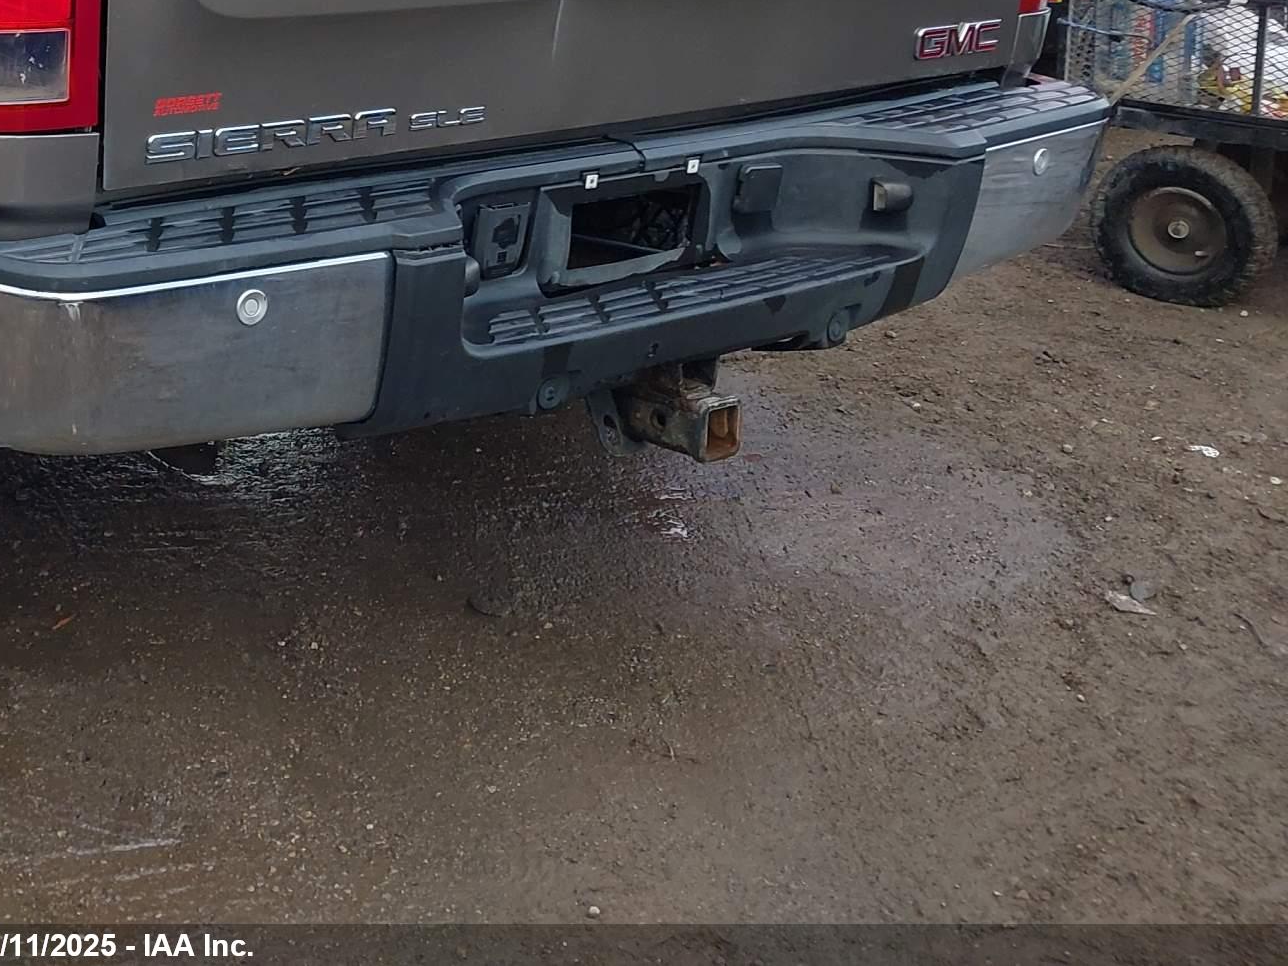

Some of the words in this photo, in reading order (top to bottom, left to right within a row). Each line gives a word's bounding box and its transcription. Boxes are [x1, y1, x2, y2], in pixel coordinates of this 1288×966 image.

[914, 19, 1002, 60] GMC
[146, 109, 396, 164] SIERRA
[410, 107, 486, 131] SLE
